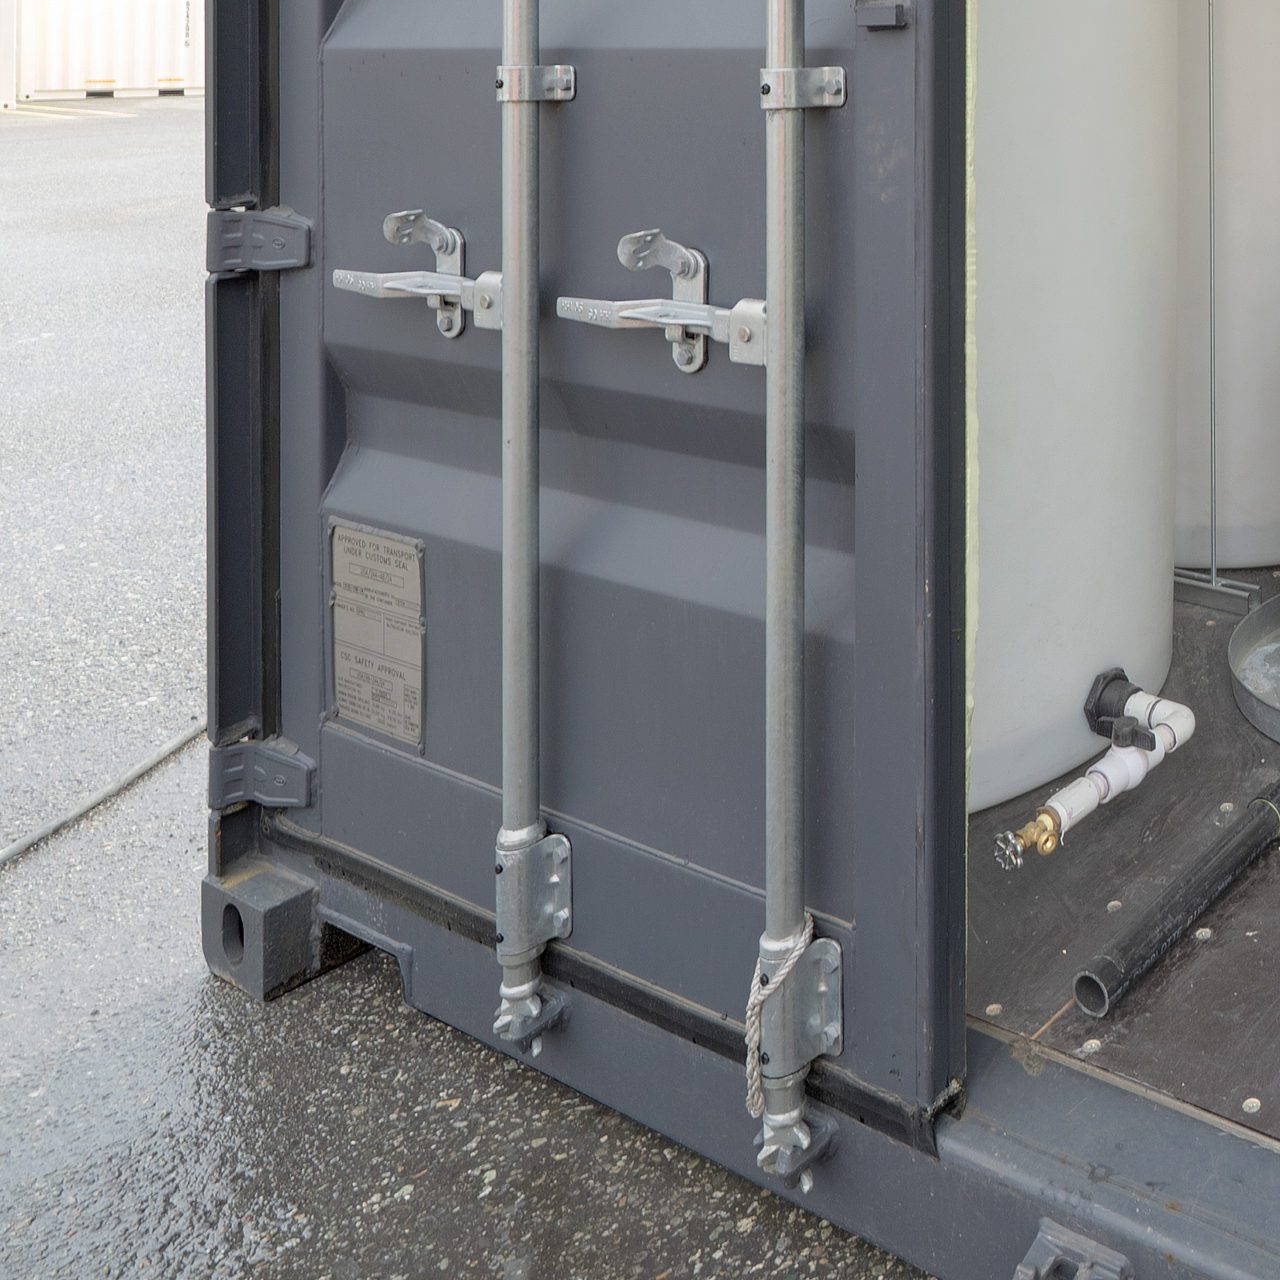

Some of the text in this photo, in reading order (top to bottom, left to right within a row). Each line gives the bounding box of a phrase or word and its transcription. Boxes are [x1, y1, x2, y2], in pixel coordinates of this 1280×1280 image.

[338, 534, 415, 561] APPROVED FOR TRANSPORT
[344, 546, 408, 571] UNDER CUSTOMS SEAL
[354, 656, 374, 669] SAFETY
[378, 664, 406, 680] APPROVAL
